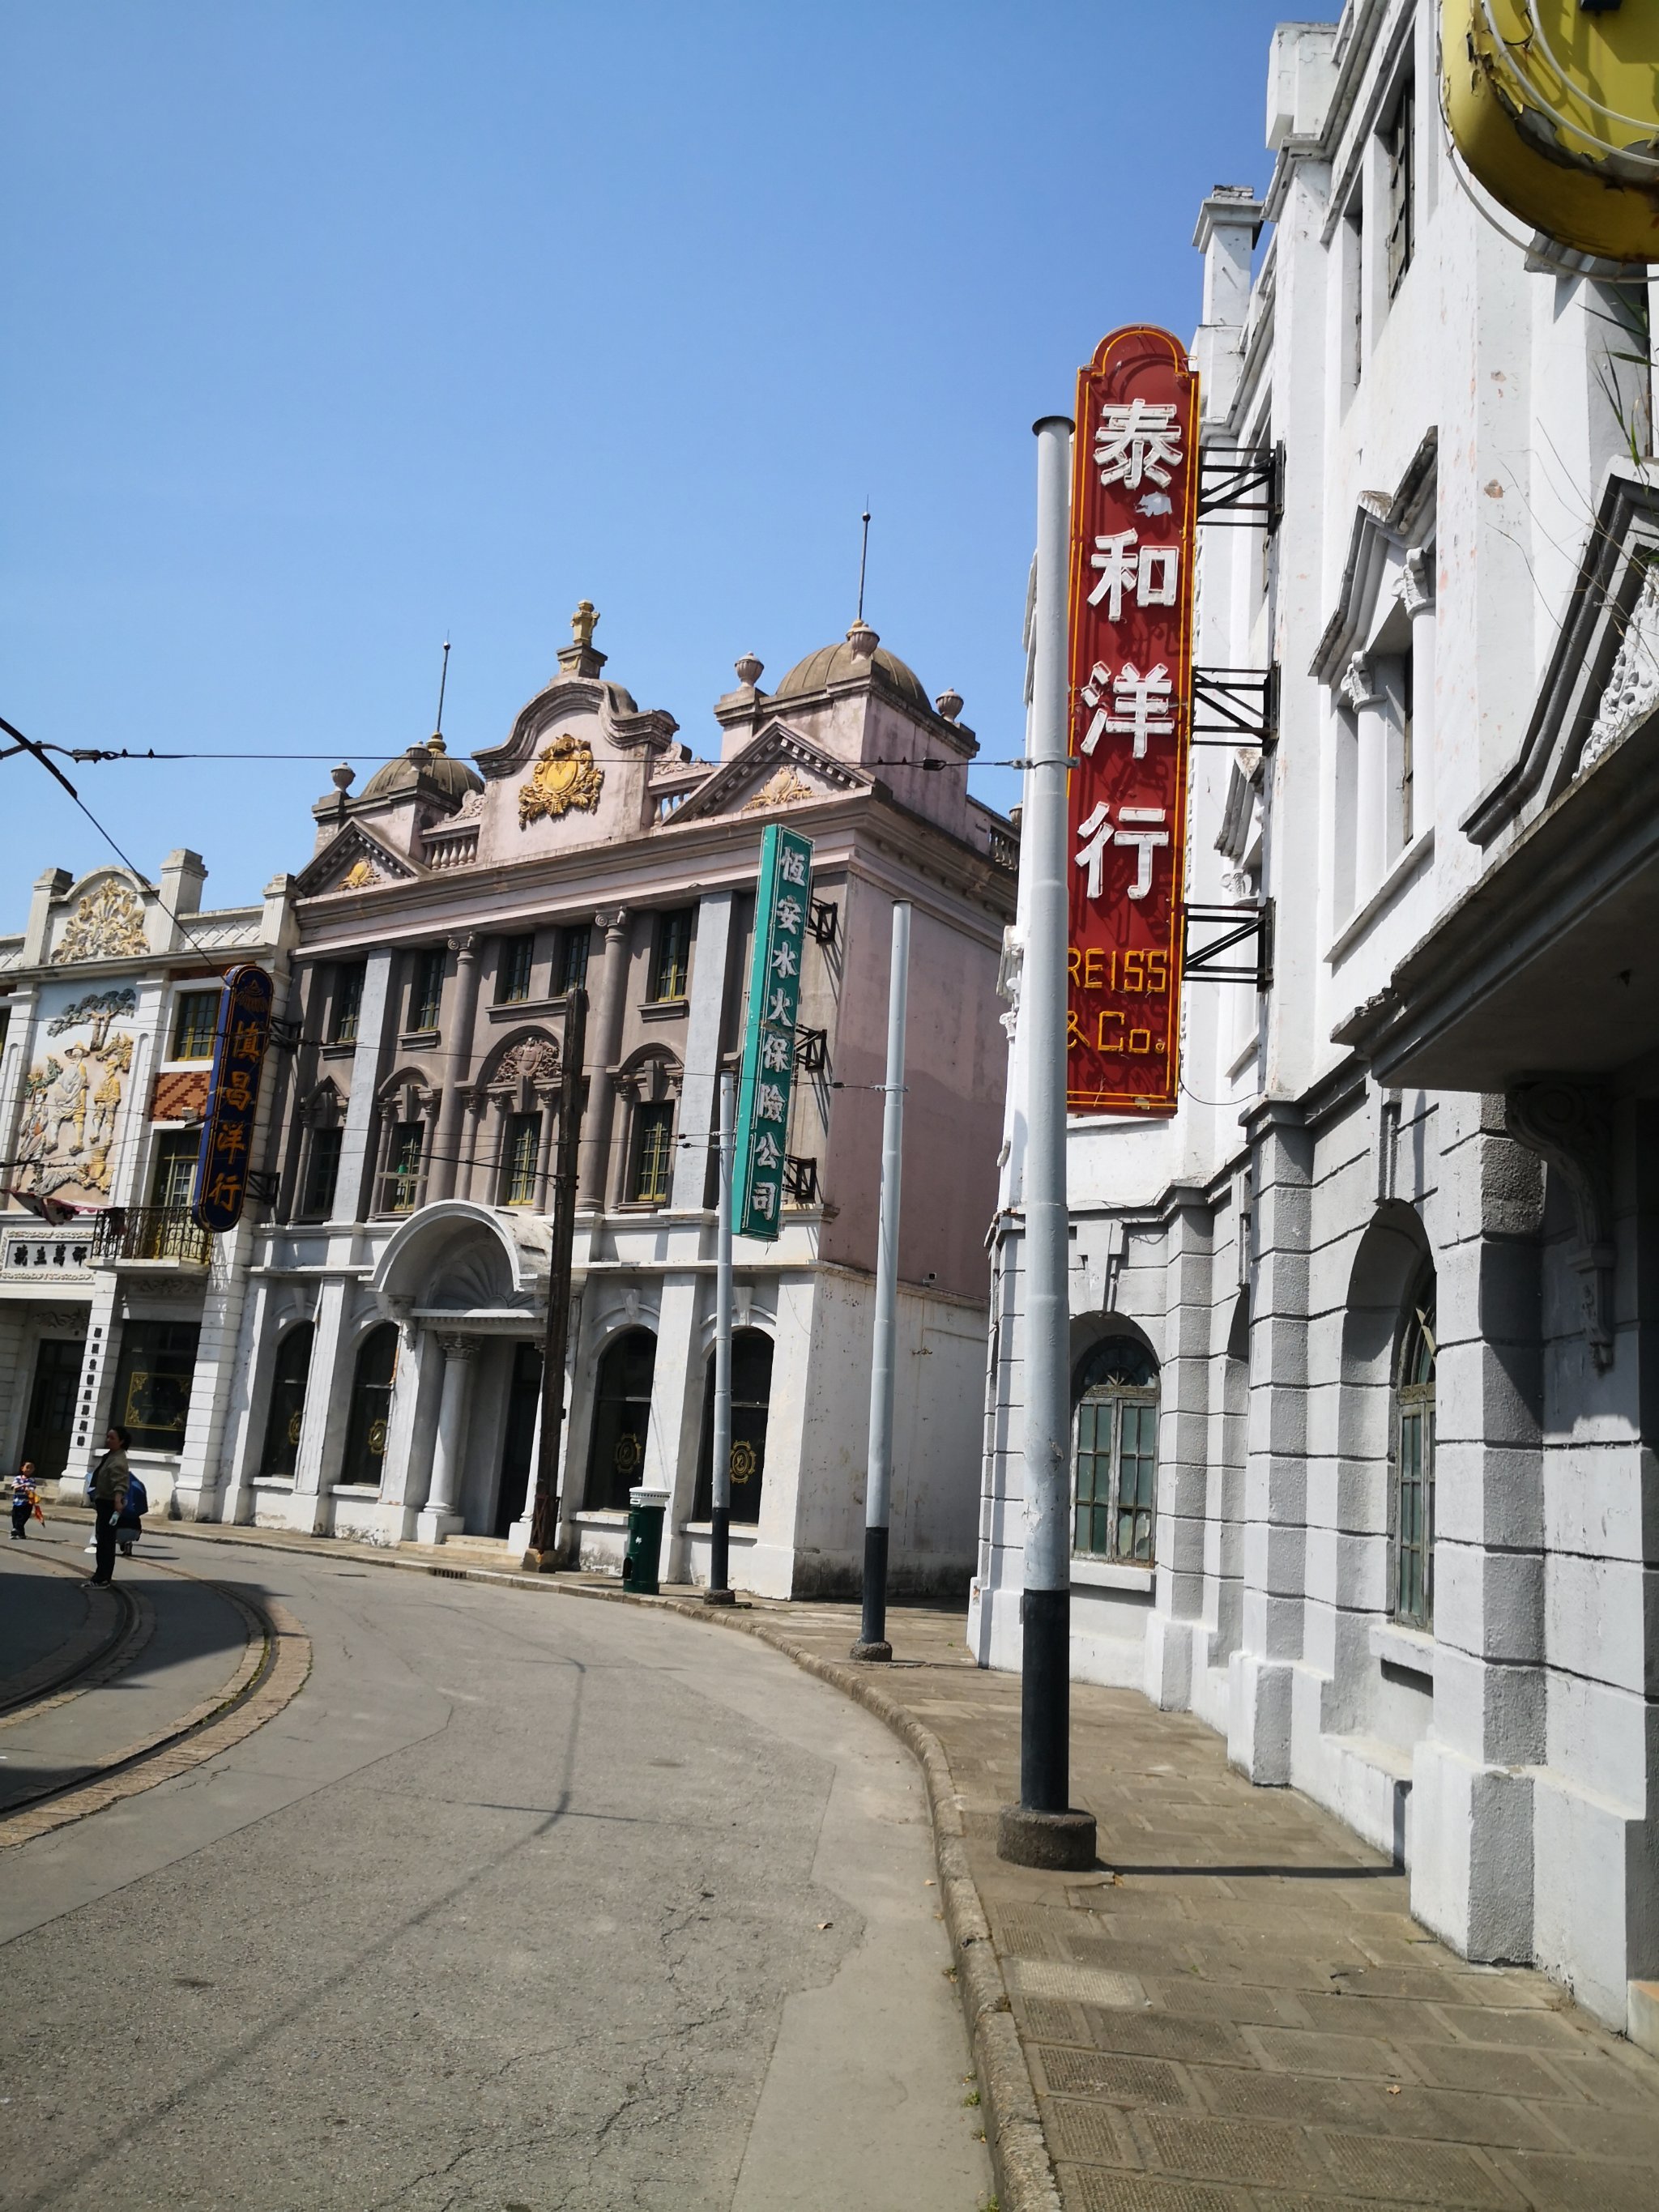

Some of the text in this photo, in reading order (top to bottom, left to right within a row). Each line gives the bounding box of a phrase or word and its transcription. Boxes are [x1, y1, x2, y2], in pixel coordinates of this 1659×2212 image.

[1074, 398, 1183, 900] 泰和洋行
[1068, 948, 1167, 992] REISS
